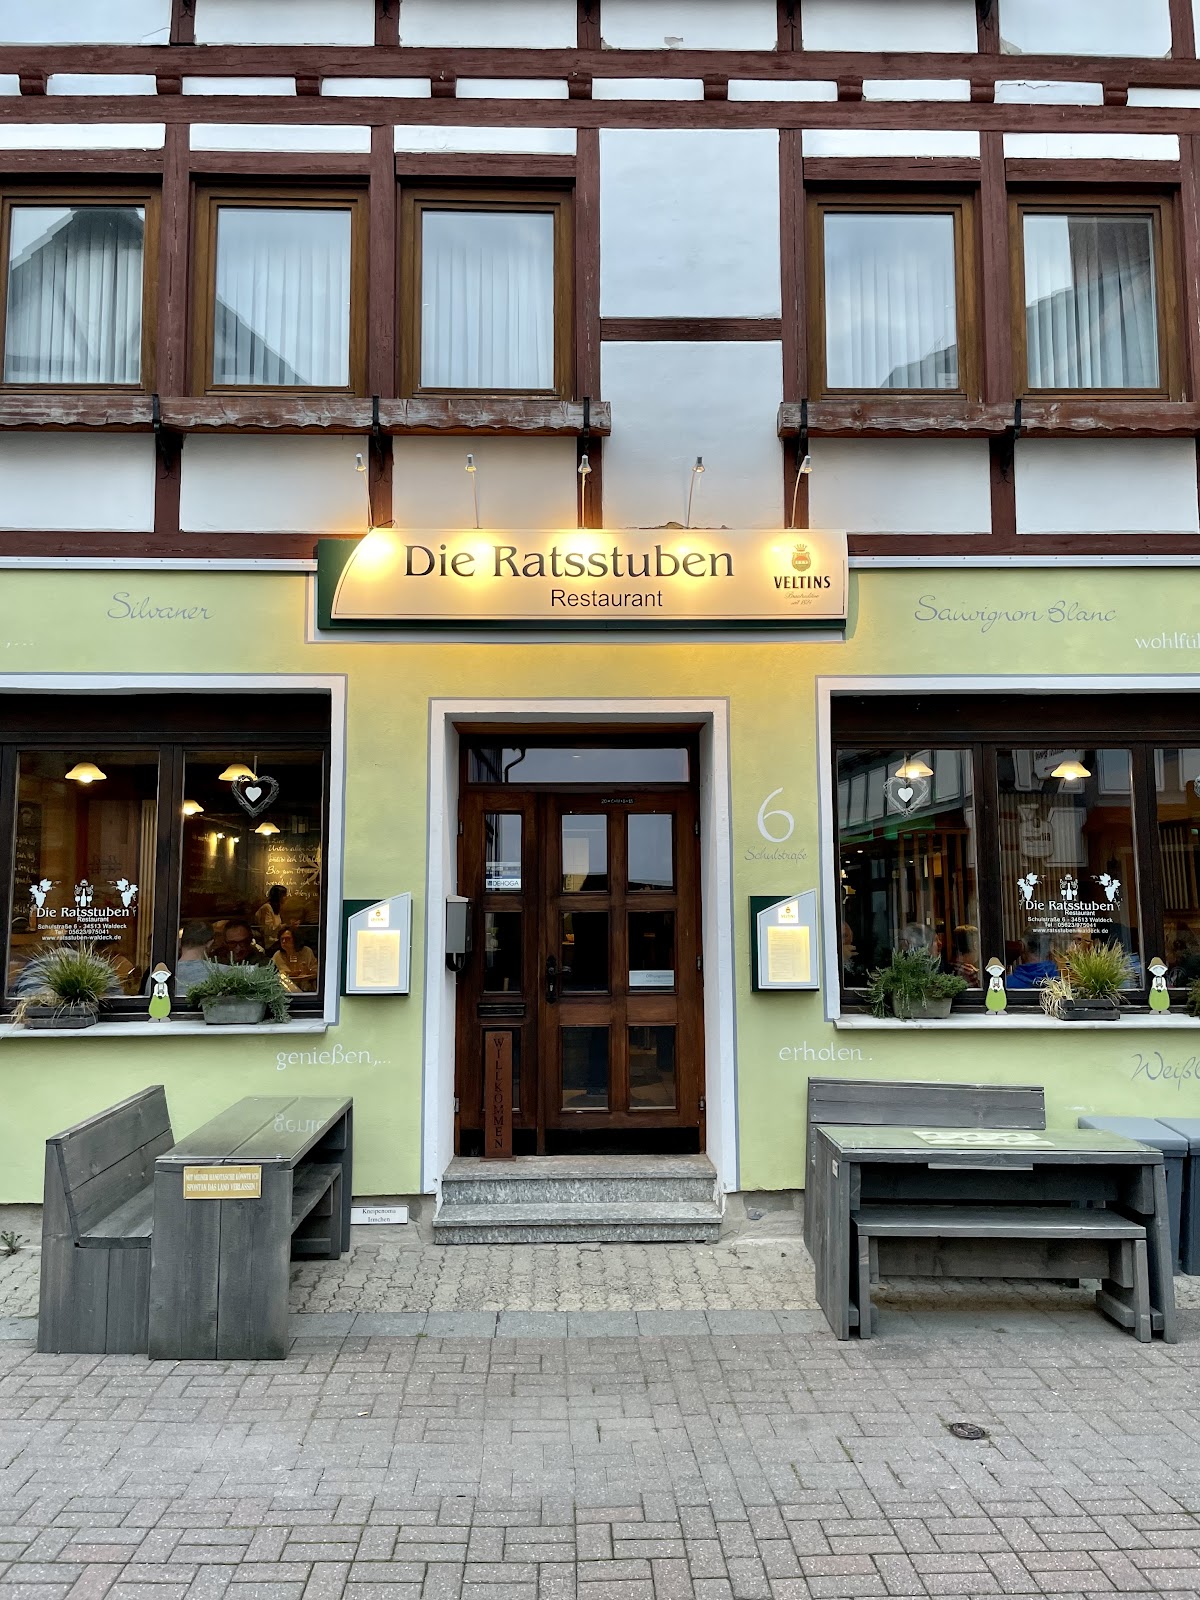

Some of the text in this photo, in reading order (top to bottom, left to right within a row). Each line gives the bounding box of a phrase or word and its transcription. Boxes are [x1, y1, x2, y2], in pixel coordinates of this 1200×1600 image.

[404, 544, 735, 578] Die Ratsstuben
[774, 575, 831, 589] VELTINS
[106, 591, 215, 620] Silvaner
[551, 589, 663, 607] Restaurant
[914, 594, 1117, 633] Sauvignon Blanc
[757, 786, 795, 843] 6
[744, 846, 807, 864] Schulstraße
[36, 907, 57, 918] Die
[61, 906, 130, 918] Ratsstuben
[1025, 900, 1114, 911] Die Ratsstuben
[493, 1037, 505, 1149] WILLKOMMEN
[187, 1183, 208, 1191] SPONTAN
[208, 1183, 217, 1191] DAS
[217, 1183, 230, 1191] LAND
